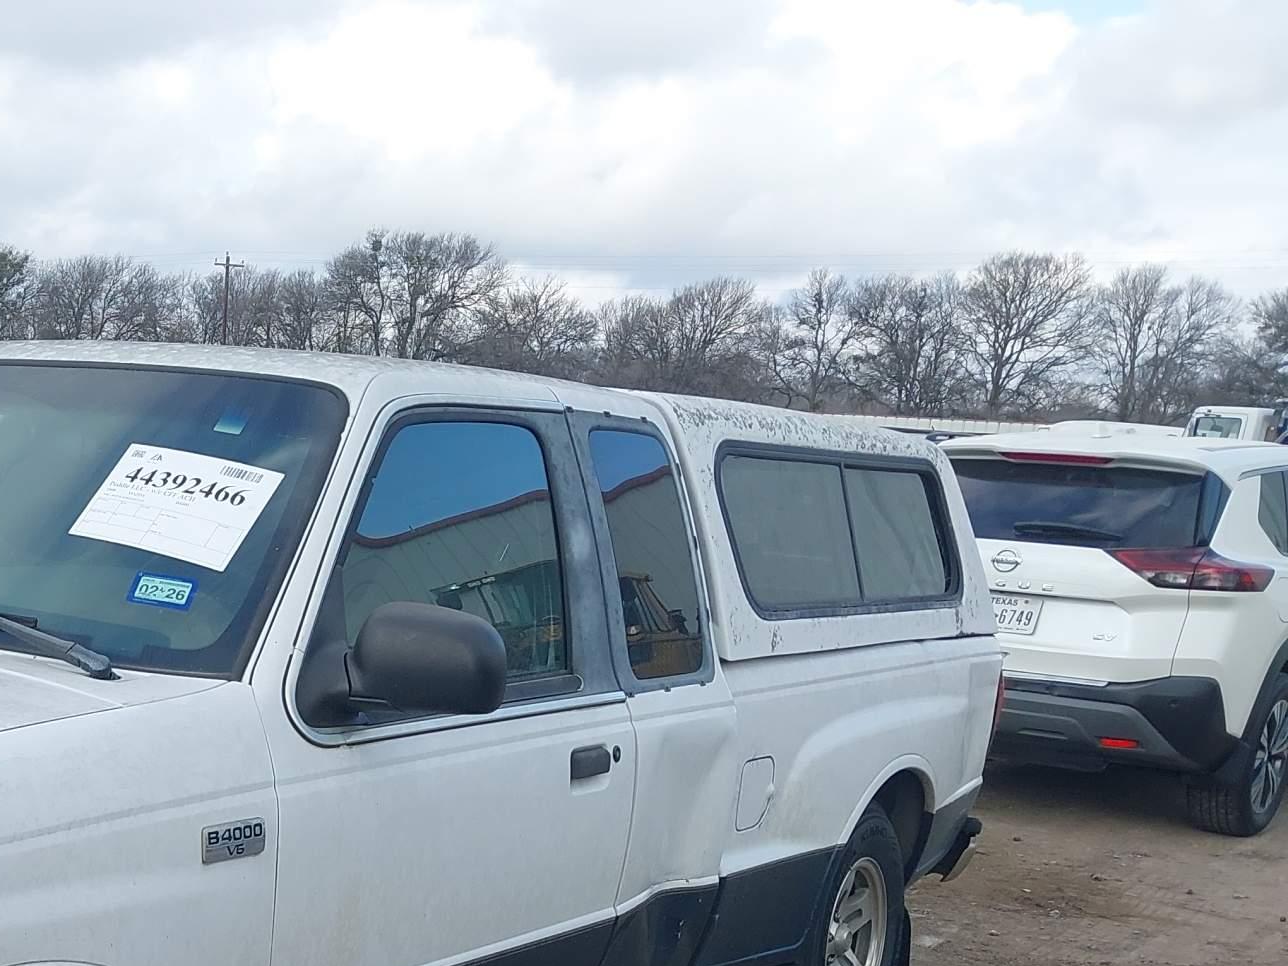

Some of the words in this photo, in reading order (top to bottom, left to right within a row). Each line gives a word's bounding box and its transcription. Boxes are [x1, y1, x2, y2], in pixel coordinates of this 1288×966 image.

[125, 467, 252, 506] 44392466
[995, 578, 1055, 592] GUE
[991, 596, 1018, 607] TEXAS
[998, 608, 1033, 626] 6749
[208, 823, 262, 844] B4000
[227, 843, 244, 855] V6
